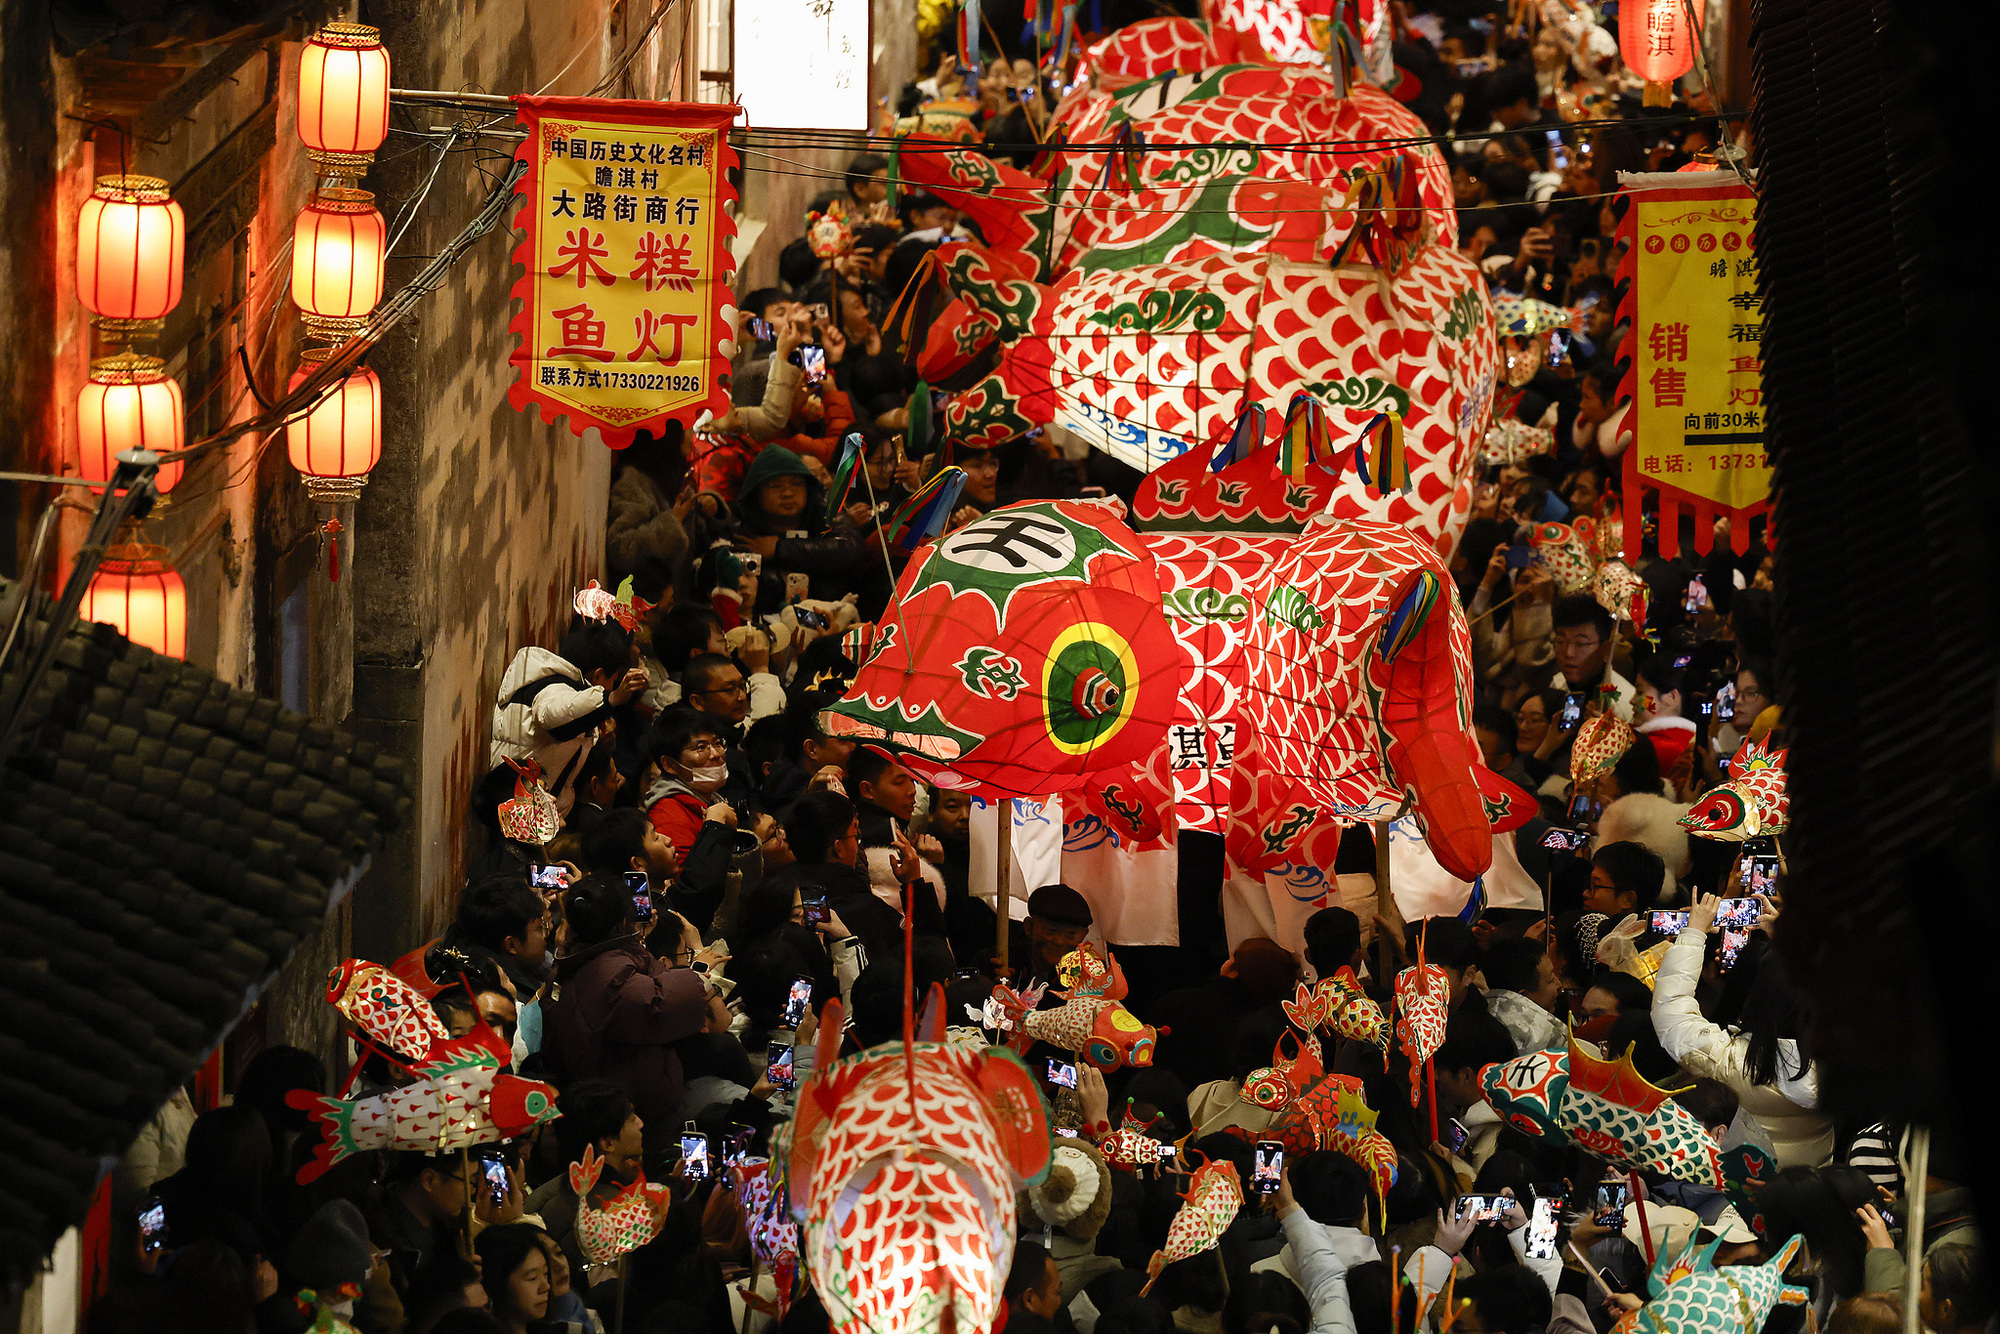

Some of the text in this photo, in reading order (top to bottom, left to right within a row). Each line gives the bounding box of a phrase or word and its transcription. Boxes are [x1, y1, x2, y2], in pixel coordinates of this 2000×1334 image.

[551, 137, 706, 167] 中国历史文化名村
[595, 165, 659, 190] 瞻淇村
[551, 189, 700, 226] 大路街商行
[547, 226, 700, 294] 米糕
[546, 302, 698, 367] 鱼灯
[541, 366, 700, 392] 联系方式17330221926
[1648, 322, 1690, 408] 销售
[1684, 411, 1760, 430] 向前30米
